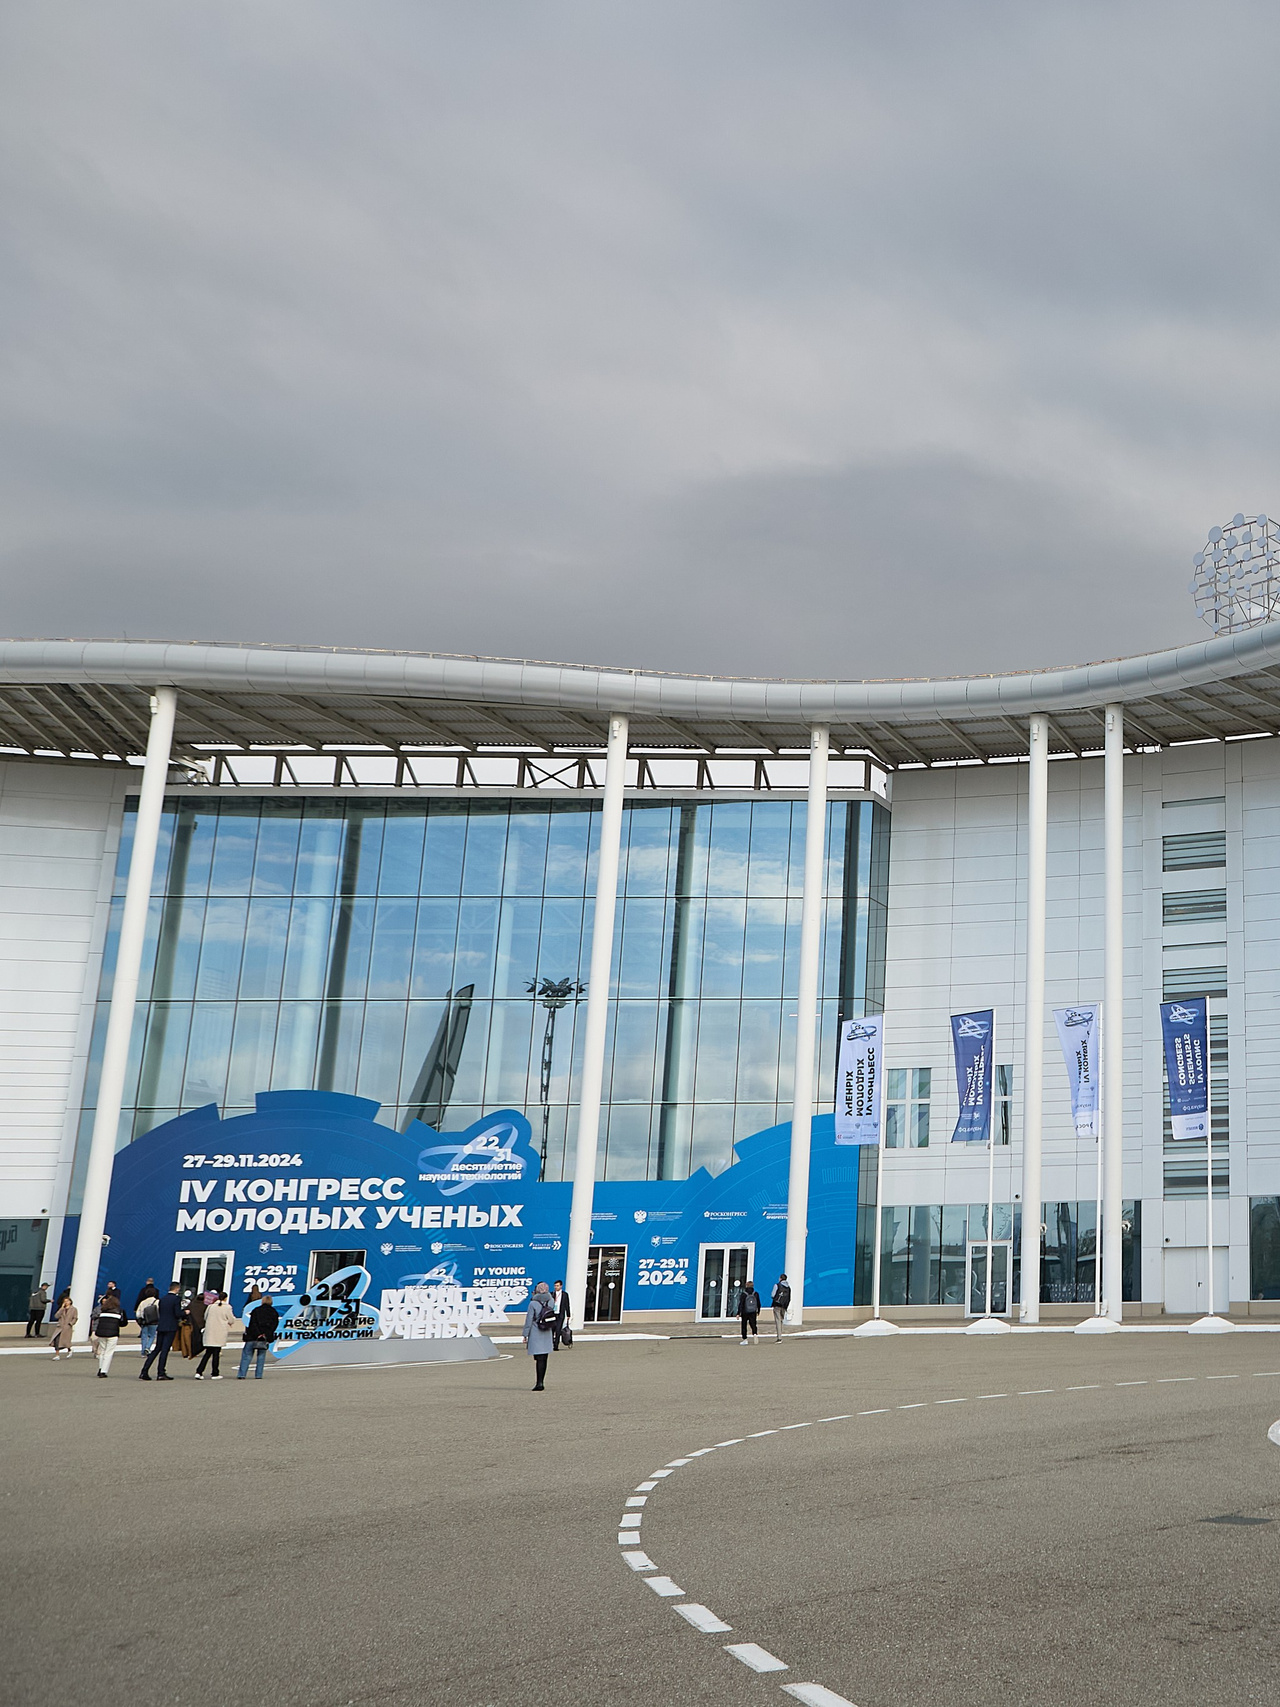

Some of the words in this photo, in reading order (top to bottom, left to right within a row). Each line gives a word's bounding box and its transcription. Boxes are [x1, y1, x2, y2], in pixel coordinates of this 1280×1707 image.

[476, 1136, 500, 1150] 22
[493, 1148, 512, 1162] 31
[451, 1162, 522, 1172] десятилетие
[418, 1173, 450, 1183] науки
[461, 1171, 522, 1180] технологий
[180, 1180, 217, 1203] IV
[224, 1177, 405, 1202] КОНГРЕСС
[176, 1208, 366, 1235] МОЛОДЫХ
[375, 1205, 524, 1230] УЧЕНЫХ
[432, 1268, 446, 1276] 22
[474, 1268, 485, 1276] IV
[488, 1267, 526, 1276] YOUNG
[638, 1270, 688, 1286] 2024
[242, 1278, 296, 1292] 2024
[472, 1278, 532, 1286] SCIENTISTS
[316, 1284, 346, 1300] 22
[338, 1298, 360, 1314] 31
[380, 1304, 509, 1322] МОЛОДЫХ
[284, 1316, 375, 1328] десятилетие
[296, 1328, 374, 1340] технологий
[378, 1322, 483, 1340] УЧЕНЫХ
